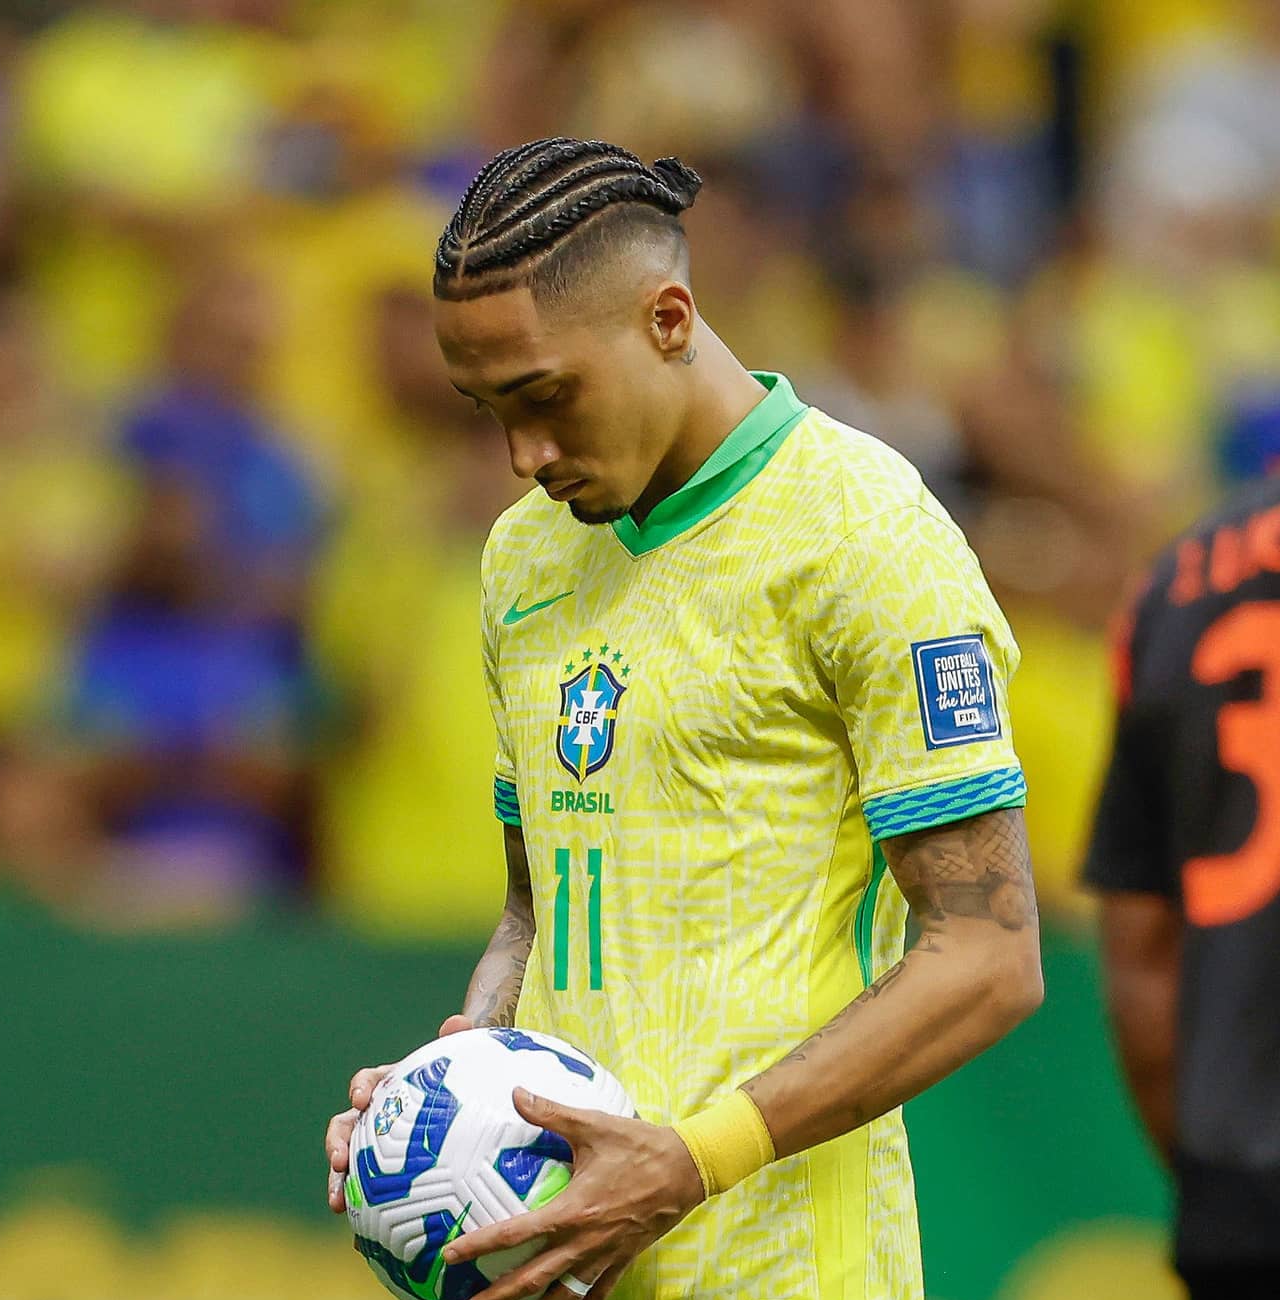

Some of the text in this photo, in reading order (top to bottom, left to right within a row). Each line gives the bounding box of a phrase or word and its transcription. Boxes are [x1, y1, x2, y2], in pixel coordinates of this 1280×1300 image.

[934, 653, 979, 672] FOOTBALL
[936, 668, 981, 692] UNITES
[936, 693, 959, 711] the
[575, 710, 599, 725] CBF
[551, 791, 615, 814] BRASIL
[553, 848, 603, 991] 11
